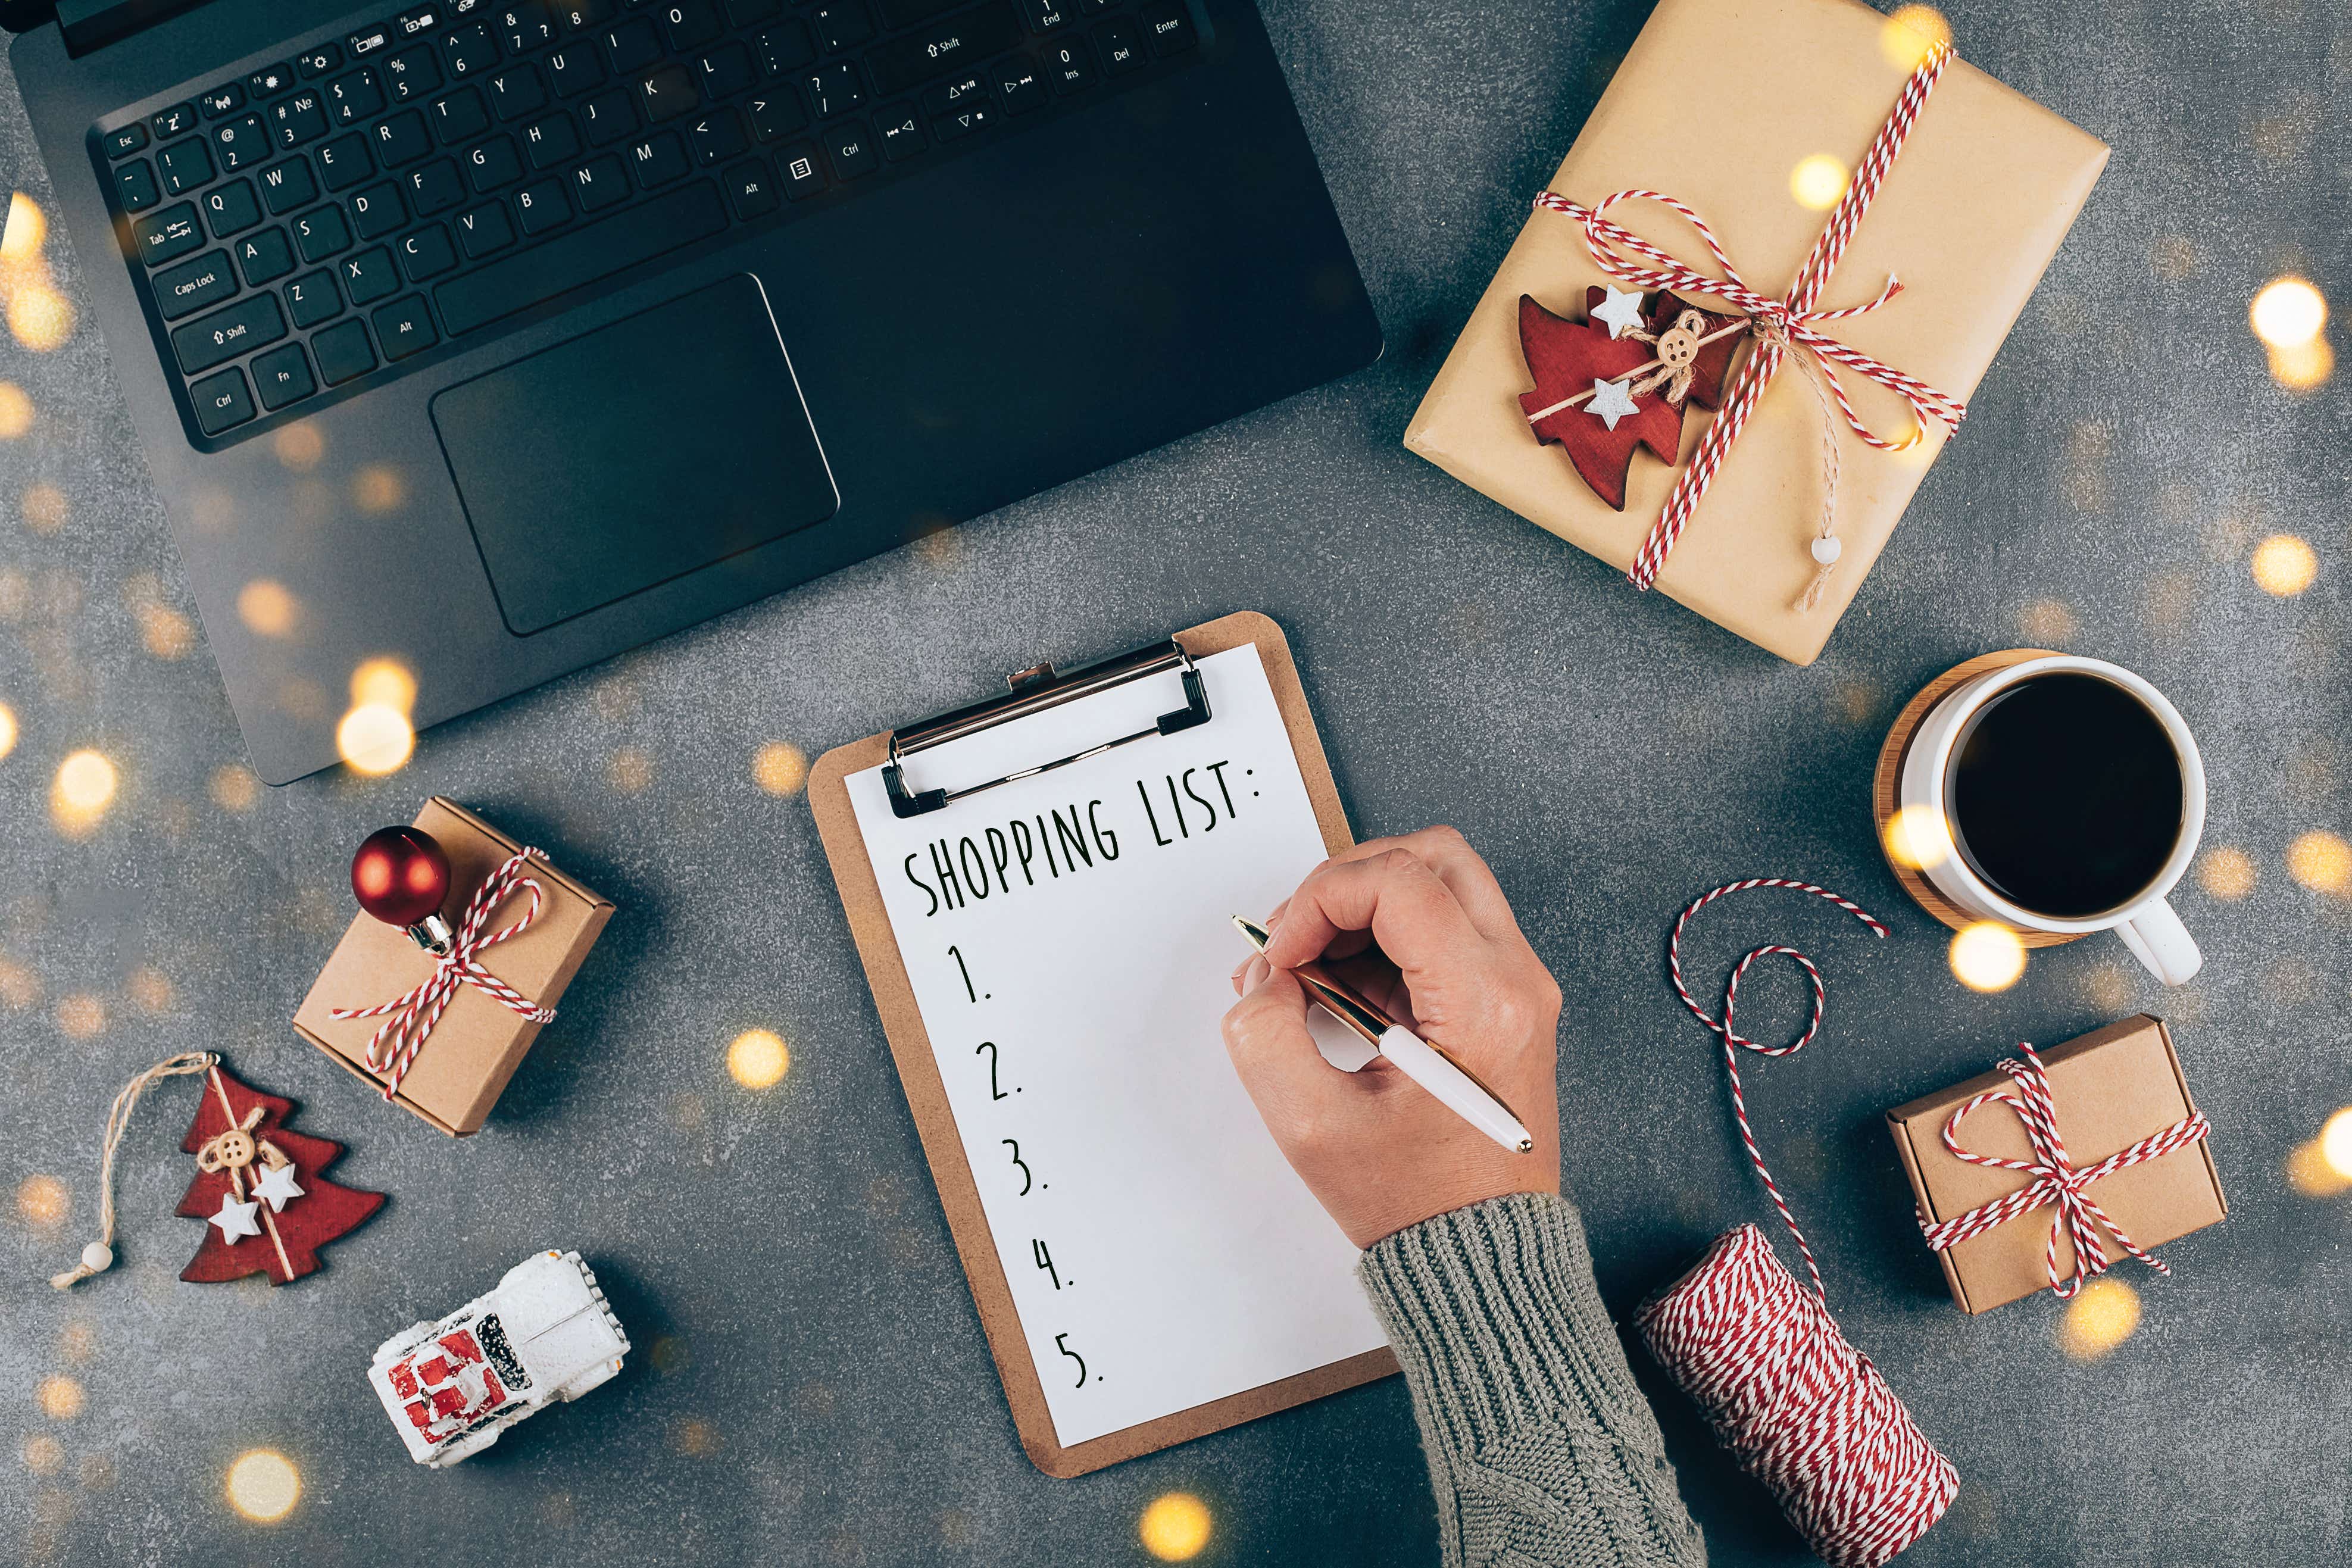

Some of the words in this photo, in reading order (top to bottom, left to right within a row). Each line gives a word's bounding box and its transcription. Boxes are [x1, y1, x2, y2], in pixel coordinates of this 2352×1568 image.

[571, 12, 581, 24] 8
[1043, 12, 1060, 26] End
[1156, 19, 1179, 33] Enter
[513, 35, 521, 48] 7
[940, 38, 960, 52] Shift
[1114, 48, 1129, 61] Del
[457, 58, 466, 71] 6
[553, 55, 564, 70] U
[703, 58, 714, 73] L
[1064, 70, 1079, 80] Ins
[399, 82, 408, 95] 5
[495, 78, 504, 93] Y
[645, 80, 658, 95] K
[343, 105, 351, 117] 4
[438, 101, 447, 116] T
[589, 105, 596, 120] J
[285, 129, 294, 142] 3
[379, 126, 392, 140] R
[529, 126, 542, 143] H
[119, 136, 133, 147] Esc
[323, 148, 334, 164] E
[473, 149, 485, 165] G
[637, 143, 652, 161] M
[842, 143, 859, 157] Ctrl
[229, 152, 238, 166] 2
[172, 176, 180, 188] 1
[266, 169, 282, 186] W
[414, 174, 423, 189] F
[579, 168, 592, 184] N
[746, 183, 759, 195] Alt
[211, 195, 224, 211] Q
[356, 197, 368, 213] D
[521, 192, 532, 207] B
[300, 220, 310, 236] S
[463, 215, 473, 230] V
[149, 233, 165, 245] Tab
[407, 238, 418, 254] C
[246, 243, 259, 259] A
[348, 261, 362, 279] X
[175, 282, 196, 296] Caps
[195, 272, 216, 288] Lock
[292, 285, 304, 301] Z
[226, 324, 246, 339] Shift
[400, 321, 413, 333] Alt
[277, 372, 290, 383] Fn
[216, 393, 232, 408] Ctrl
[904, 800, 1119, 917] SHOPPING
[1136, 760, 1259, 847] LIST:
[948, 945, 992, 1003] 1.
[976, 1042, 1023, 1101] 2.
[1002, 1138, 1049, 1197] 3.
[1032, 1238, 1075, 1290] 4.
[1054, 1332, 1104, 1389] 5.
